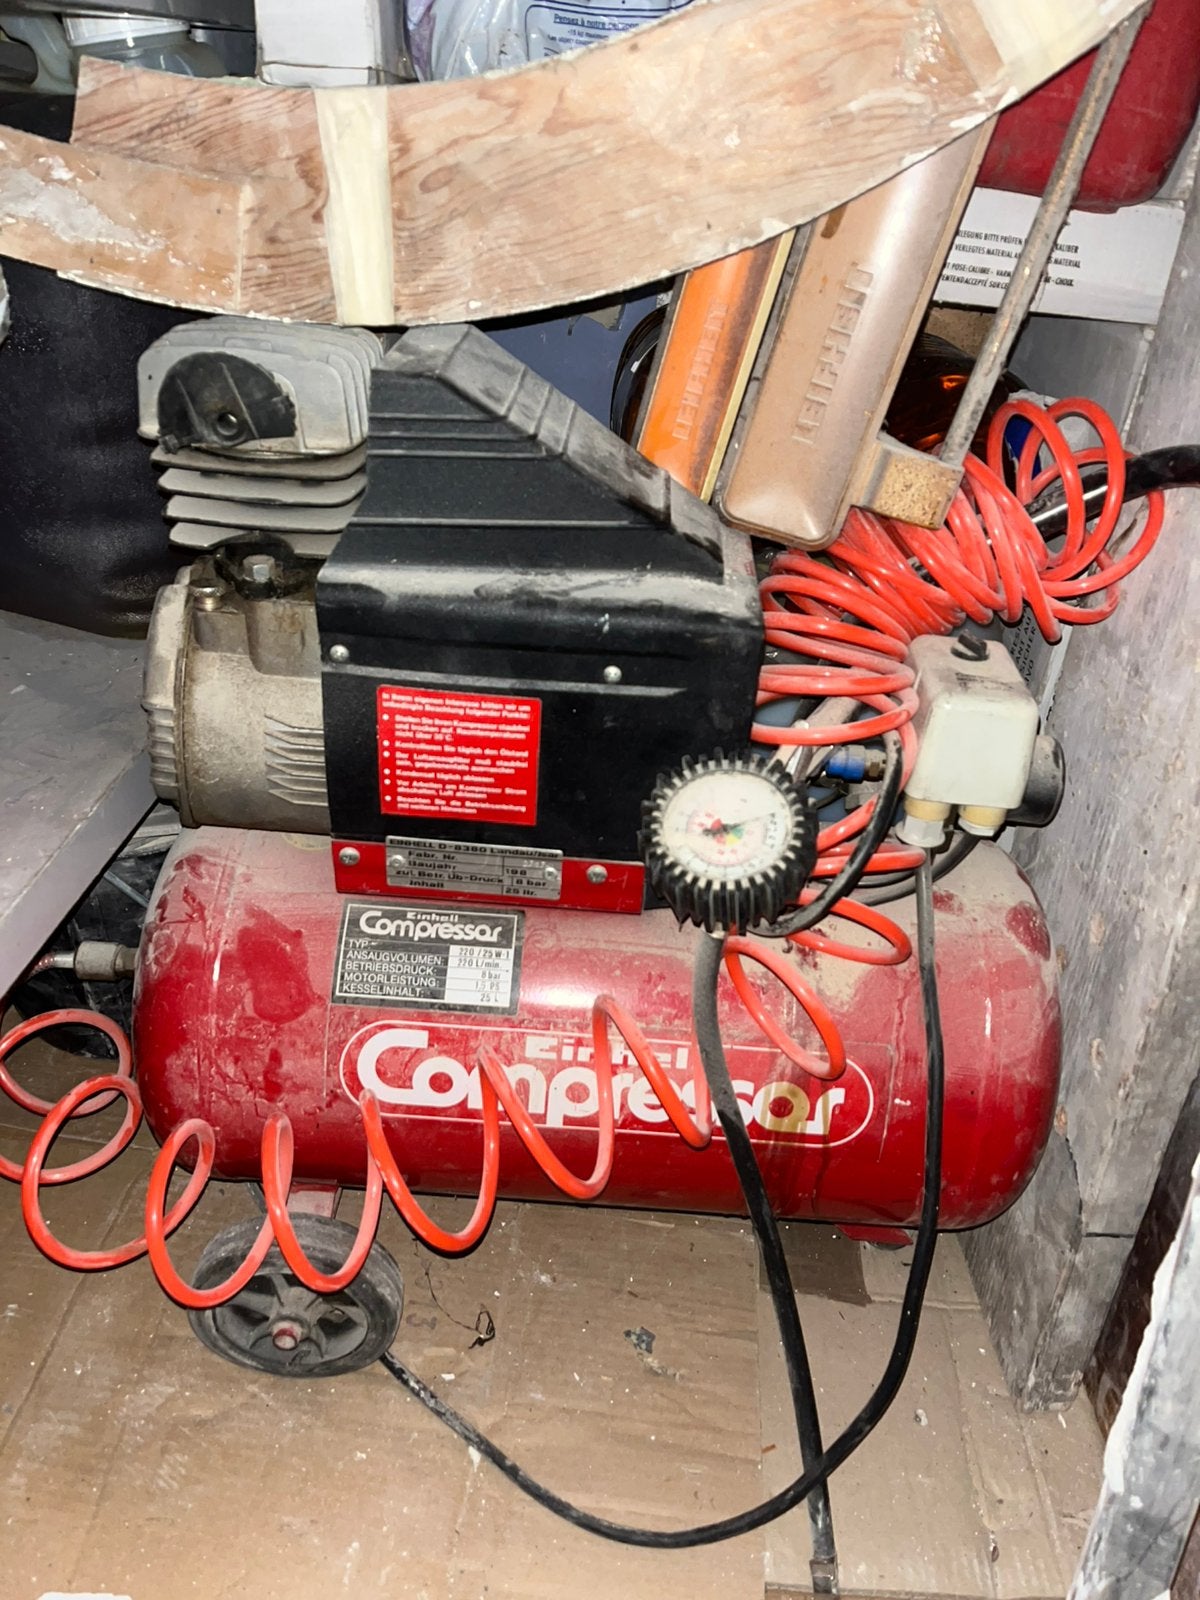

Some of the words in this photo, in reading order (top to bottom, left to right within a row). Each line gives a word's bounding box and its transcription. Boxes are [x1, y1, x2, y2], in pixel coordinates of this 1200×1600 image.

[554, 14, 578, 25] Pensez
[587, 20, 605, 29] notre
[984, 232, 1000, 242] BITTE
[1001, 234, 1023, 245] PRÜFEN
[955, 243, 985, 255] VERLEGTES
[986, 247, 1013, 259] MATERIAL
[1053, 258, 1081, 269] MATERIAL
[406, 912, 459, 922] Einhell
[359, 910, 503, 942] Compressor
[459, 948, 474, 956] 220
[345, 961, 437, 975] BETRIEBSDRUCK:
[458, 958, 473, 966] 220
[344, 972, 440, 987] MOTORLEISTUNG:
[343, 984, 424, 997] KESSELINHALT:
